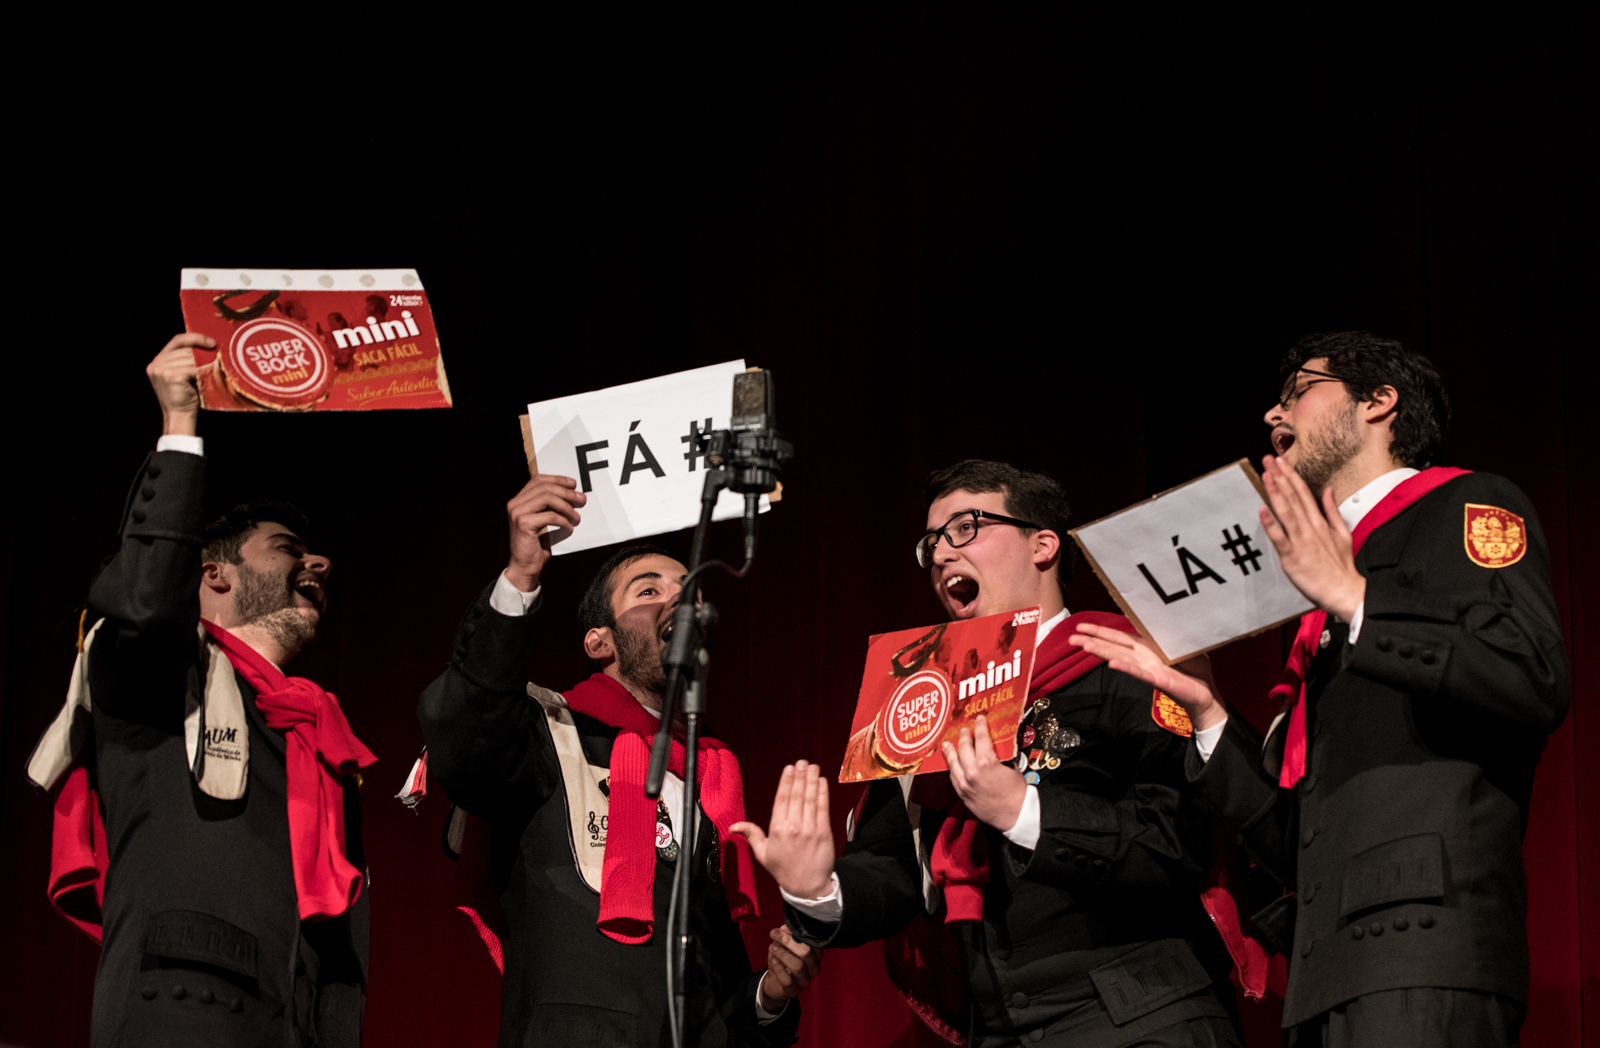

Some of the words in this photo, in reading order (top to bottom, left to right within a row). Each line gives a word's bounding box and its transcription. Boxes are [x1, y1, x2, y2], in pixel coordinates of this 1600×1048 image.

[389, 294, 402, 307] 24
[332, 310, 420, 349] mini
[246, 338, 306, 362] SUPER
[353, 348, 390, 367] SACA
[389, 342, 422, 360] FÁCIL
[255, 352, 311, 375] BOCK
[272, 366, 308, 385] mini
[347, 385, 388, 402] Sabor
[575, 419, 666, 494] FÁ
[1136, 534, 1227, 605] LÁ
[1220, 523, 1263, 576] #
[1011, 611, 1025, 627] 24
[958, 649, 1022, 700] mini
[896, 689, 939, 719] SUPER
[964, 699, 989, 718] SACA
[989, 686, 1015, 707] FÁCIL
[899, 703, 937, 732] BOCK
[904, 719, 931, 742] mini
